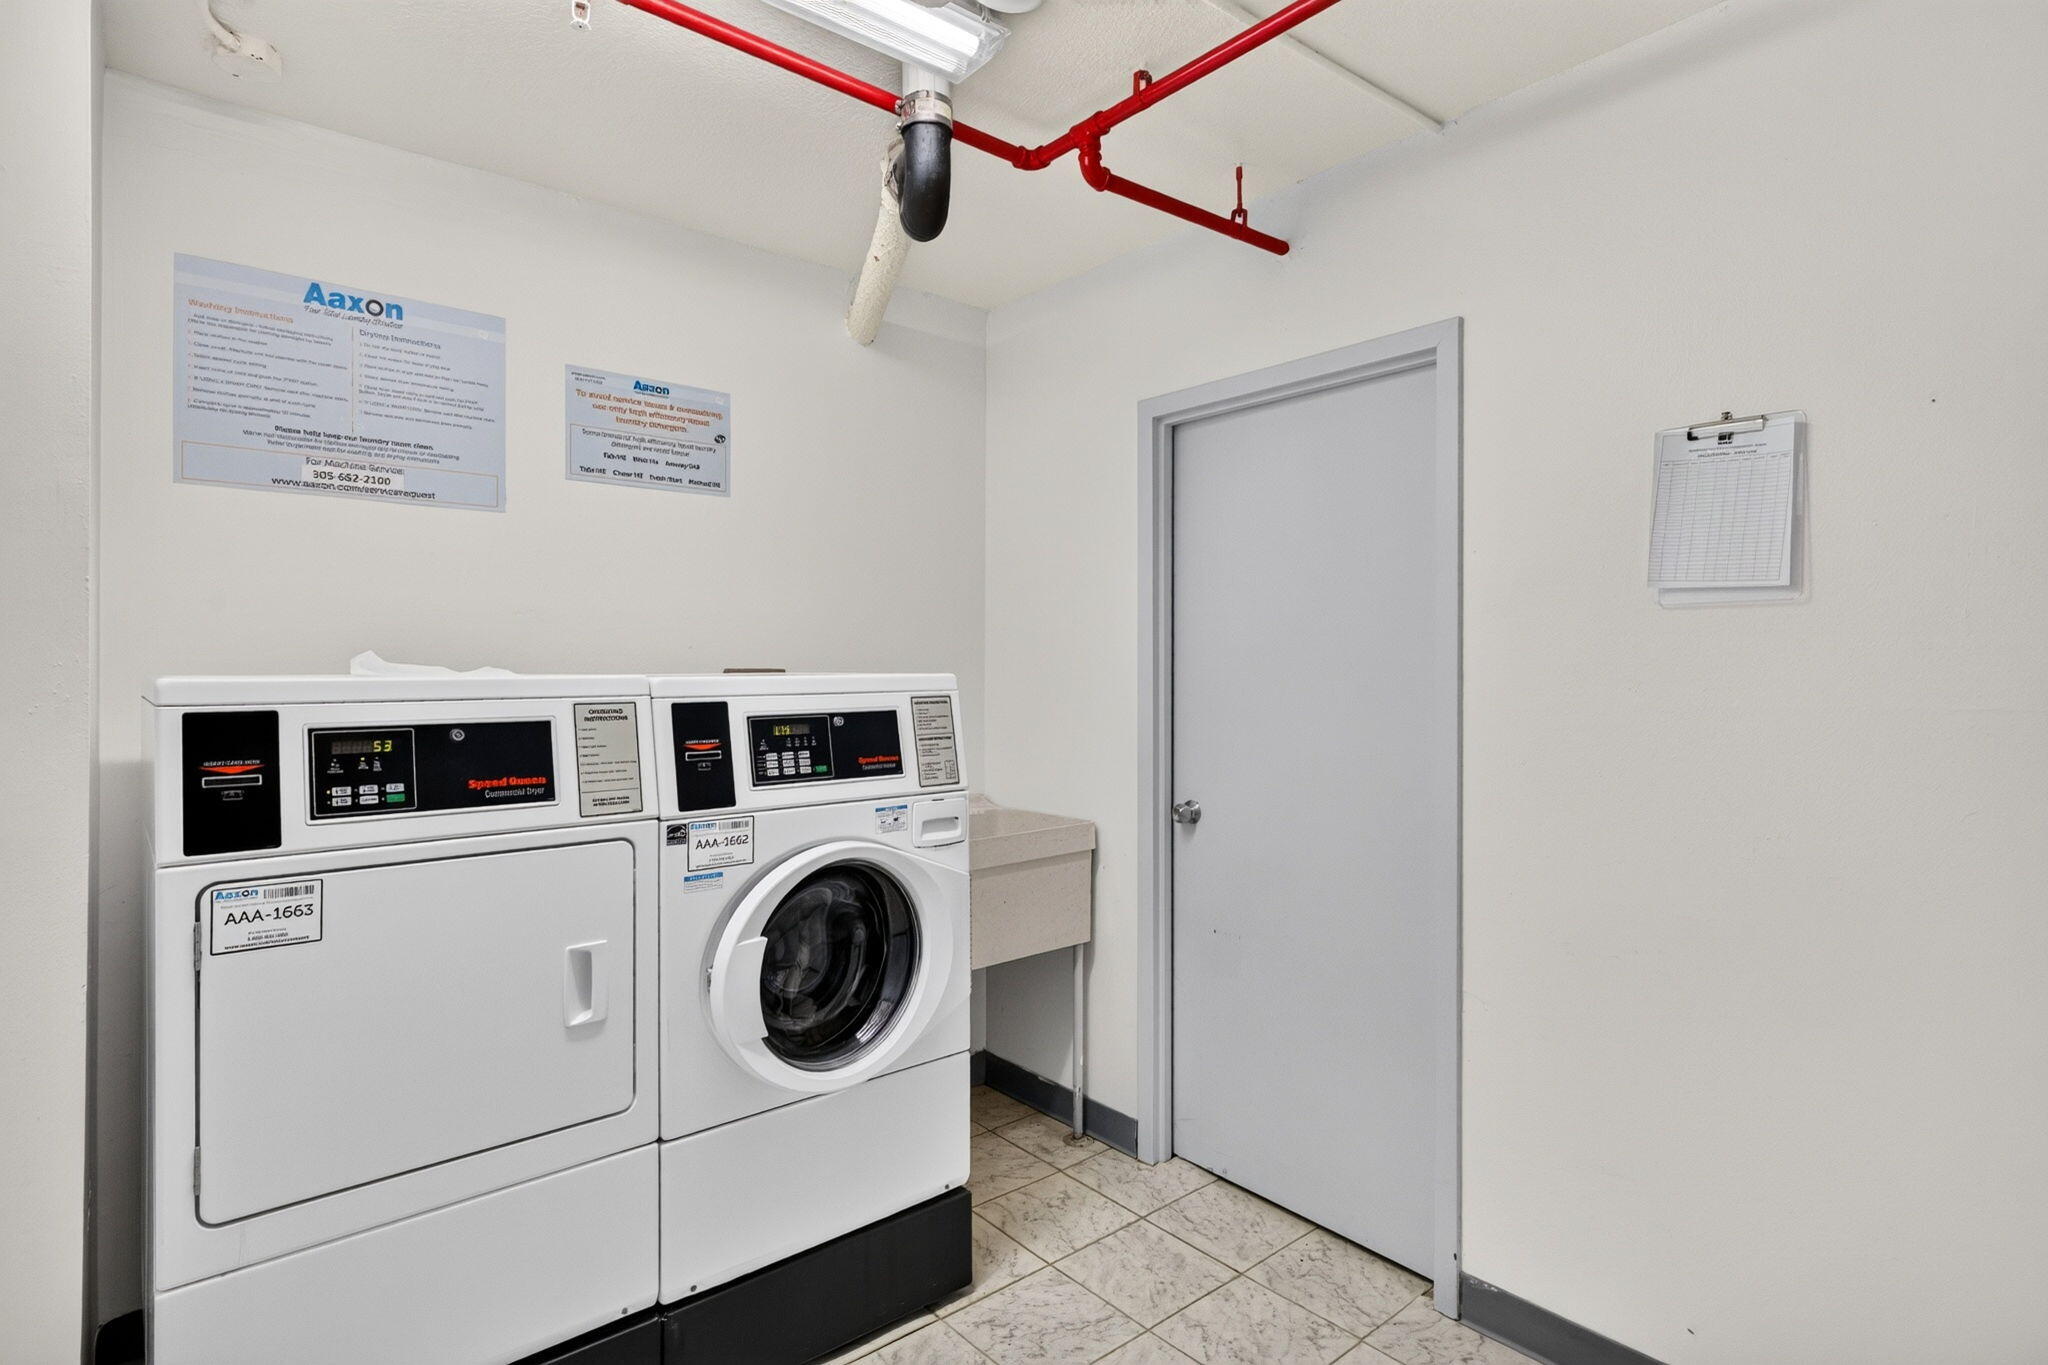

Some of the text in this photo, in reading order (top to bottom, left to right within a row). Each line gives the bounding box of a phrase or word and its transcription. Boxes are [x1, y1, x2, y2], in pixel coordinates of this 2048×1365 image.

[303, 282, 403, 320] Aaxon
[373, 740, 392, 752] 53
[224, 903, 314, 926] AAA-1663
